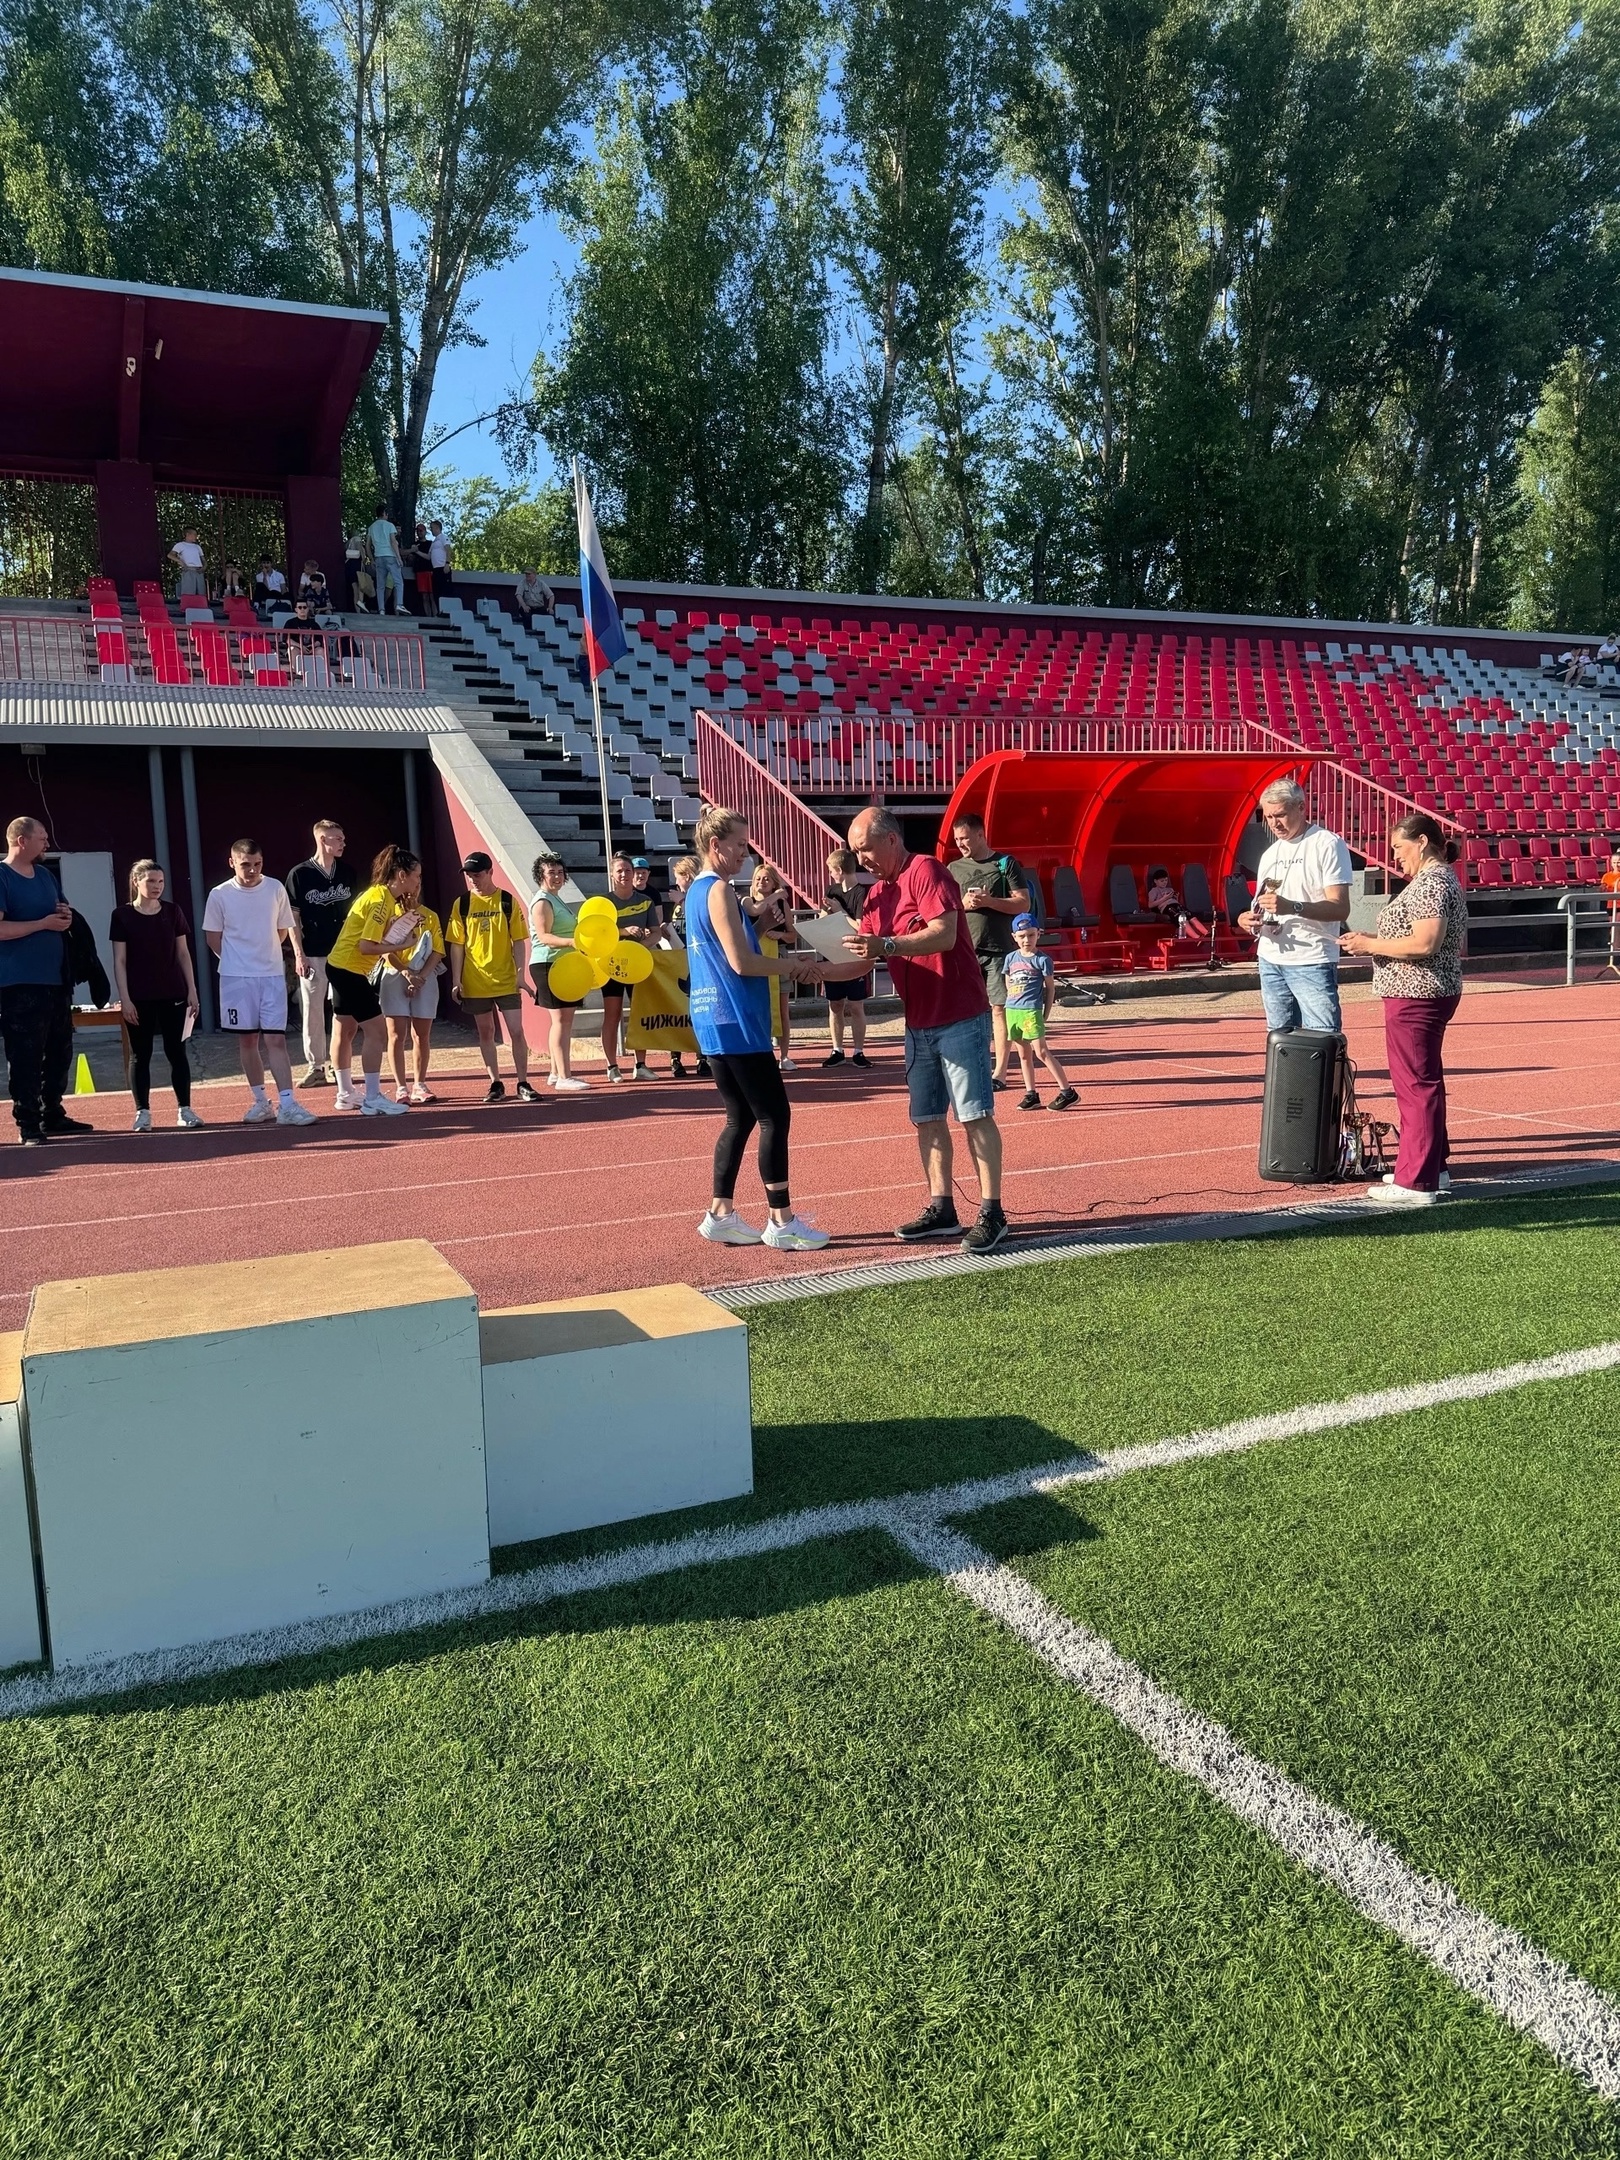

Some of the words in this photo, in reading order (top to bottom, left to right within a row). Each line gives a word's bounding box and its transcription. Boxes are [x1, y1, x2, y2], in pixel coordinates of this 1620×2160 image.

[227, 1008, 238, 1025] 13
[640, 1013, 693, 1031] ЧИЖИК
[1286, 1097, 1304, 1123] JBL
